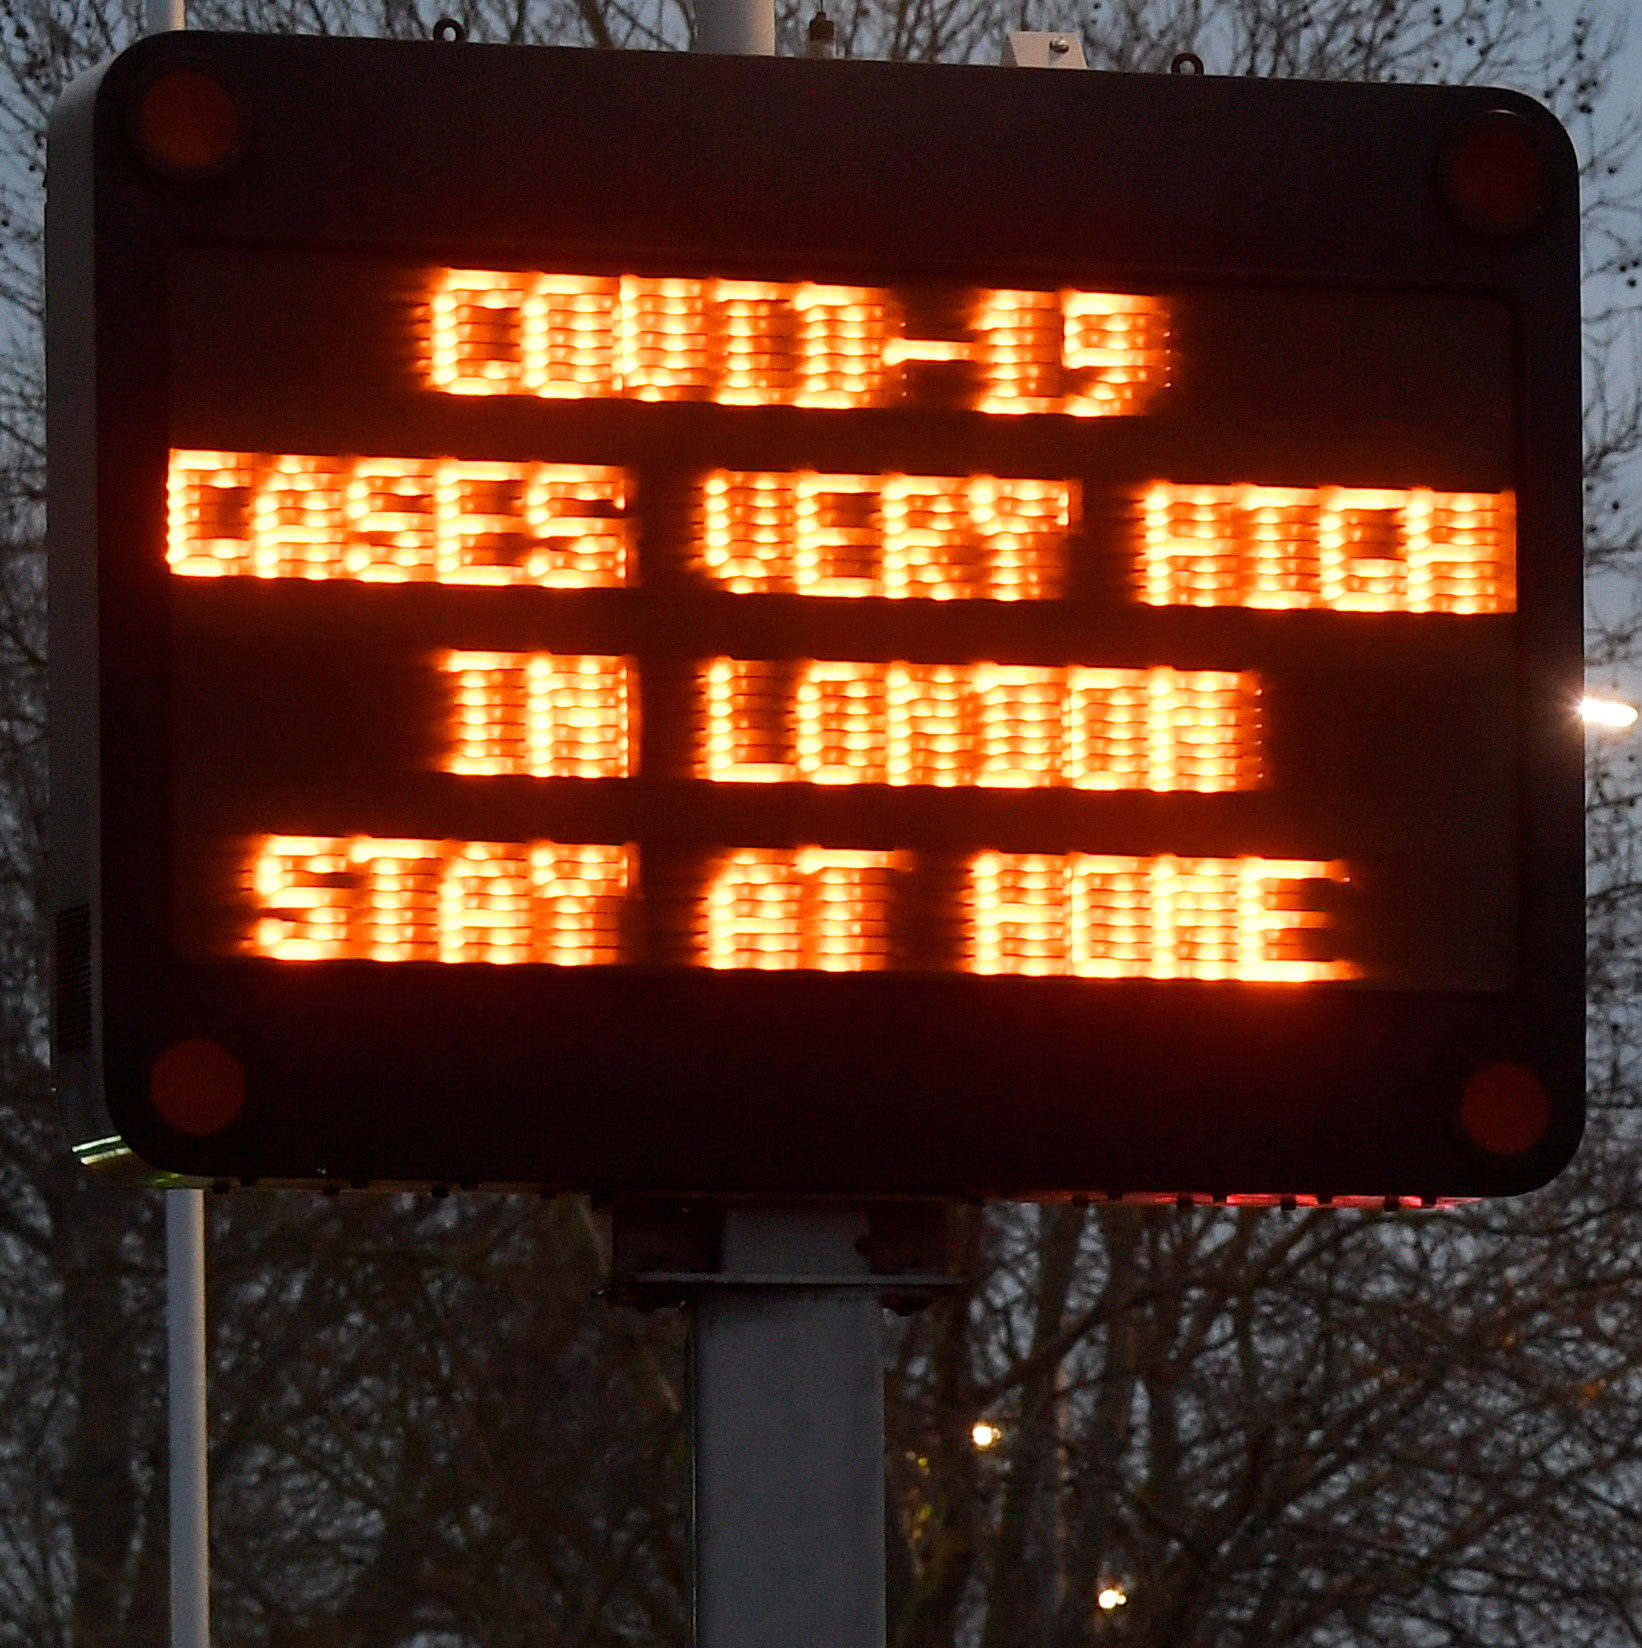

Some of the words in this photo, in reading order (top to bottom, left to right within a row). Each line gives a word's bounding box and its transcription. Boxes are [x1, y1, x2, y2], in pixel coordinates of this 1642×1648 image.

[424, 267, 1170, 417] COVID-19
[164, 447, 628, 589] CASES
[698, 471, 1070, 602] VERY
[1137, 482, 1516, 614] HIGH
[440, 649, 632, 779] IN
[697, 657, 1262, 793] LONDON
[250, 834, 630, 967] STAY
[697, 845, 905, 973] AT
[963, 852, 1352, 983] HOME
